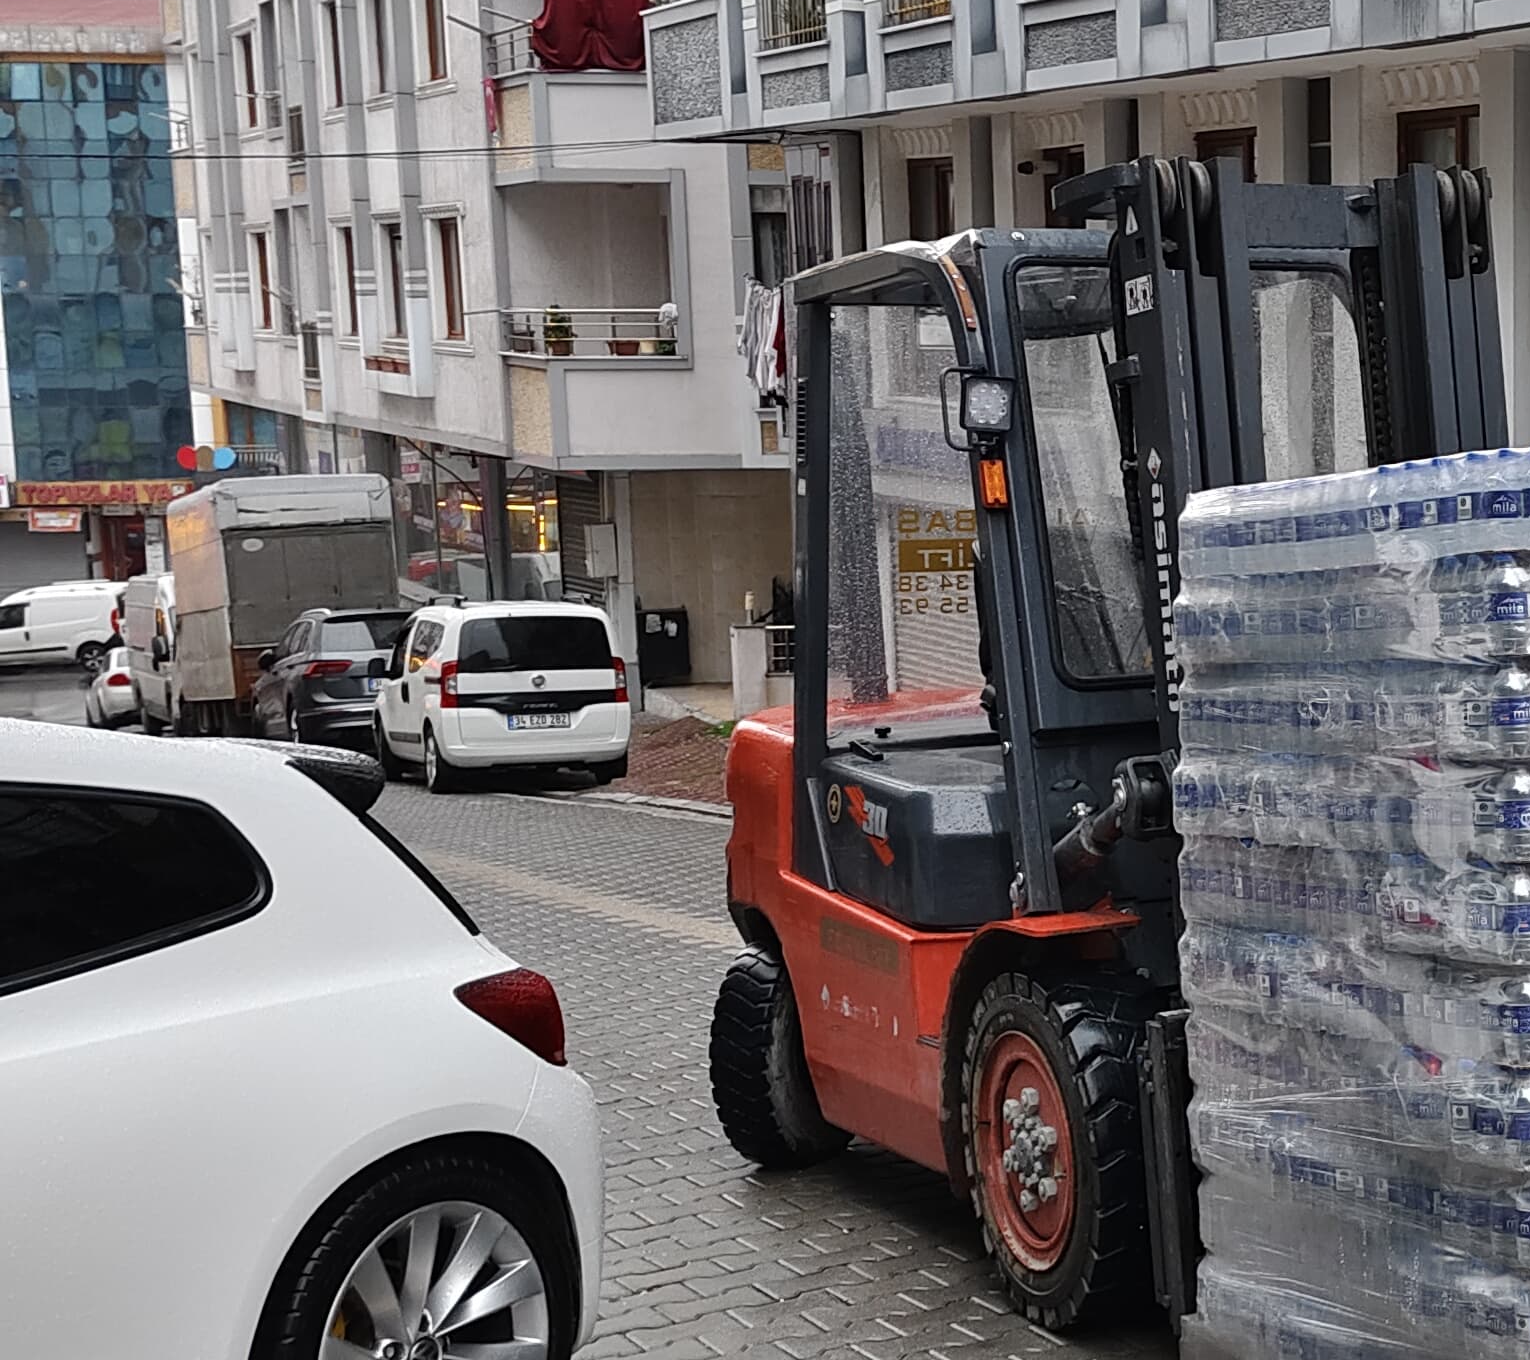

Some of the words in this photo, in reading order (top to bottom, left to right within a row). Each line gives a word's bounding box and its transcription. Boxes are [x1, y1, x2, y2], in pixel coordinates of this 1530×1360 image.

[22, 485, 138, 503] TOPUZLAR
[1492, 501, 1517, 514] mila
[1496, 602, 1524, 614] mila
[515, 716, 527, 726] 34
[550, 714, 567, 724] 282
[862, 800, 888, 839] 30
